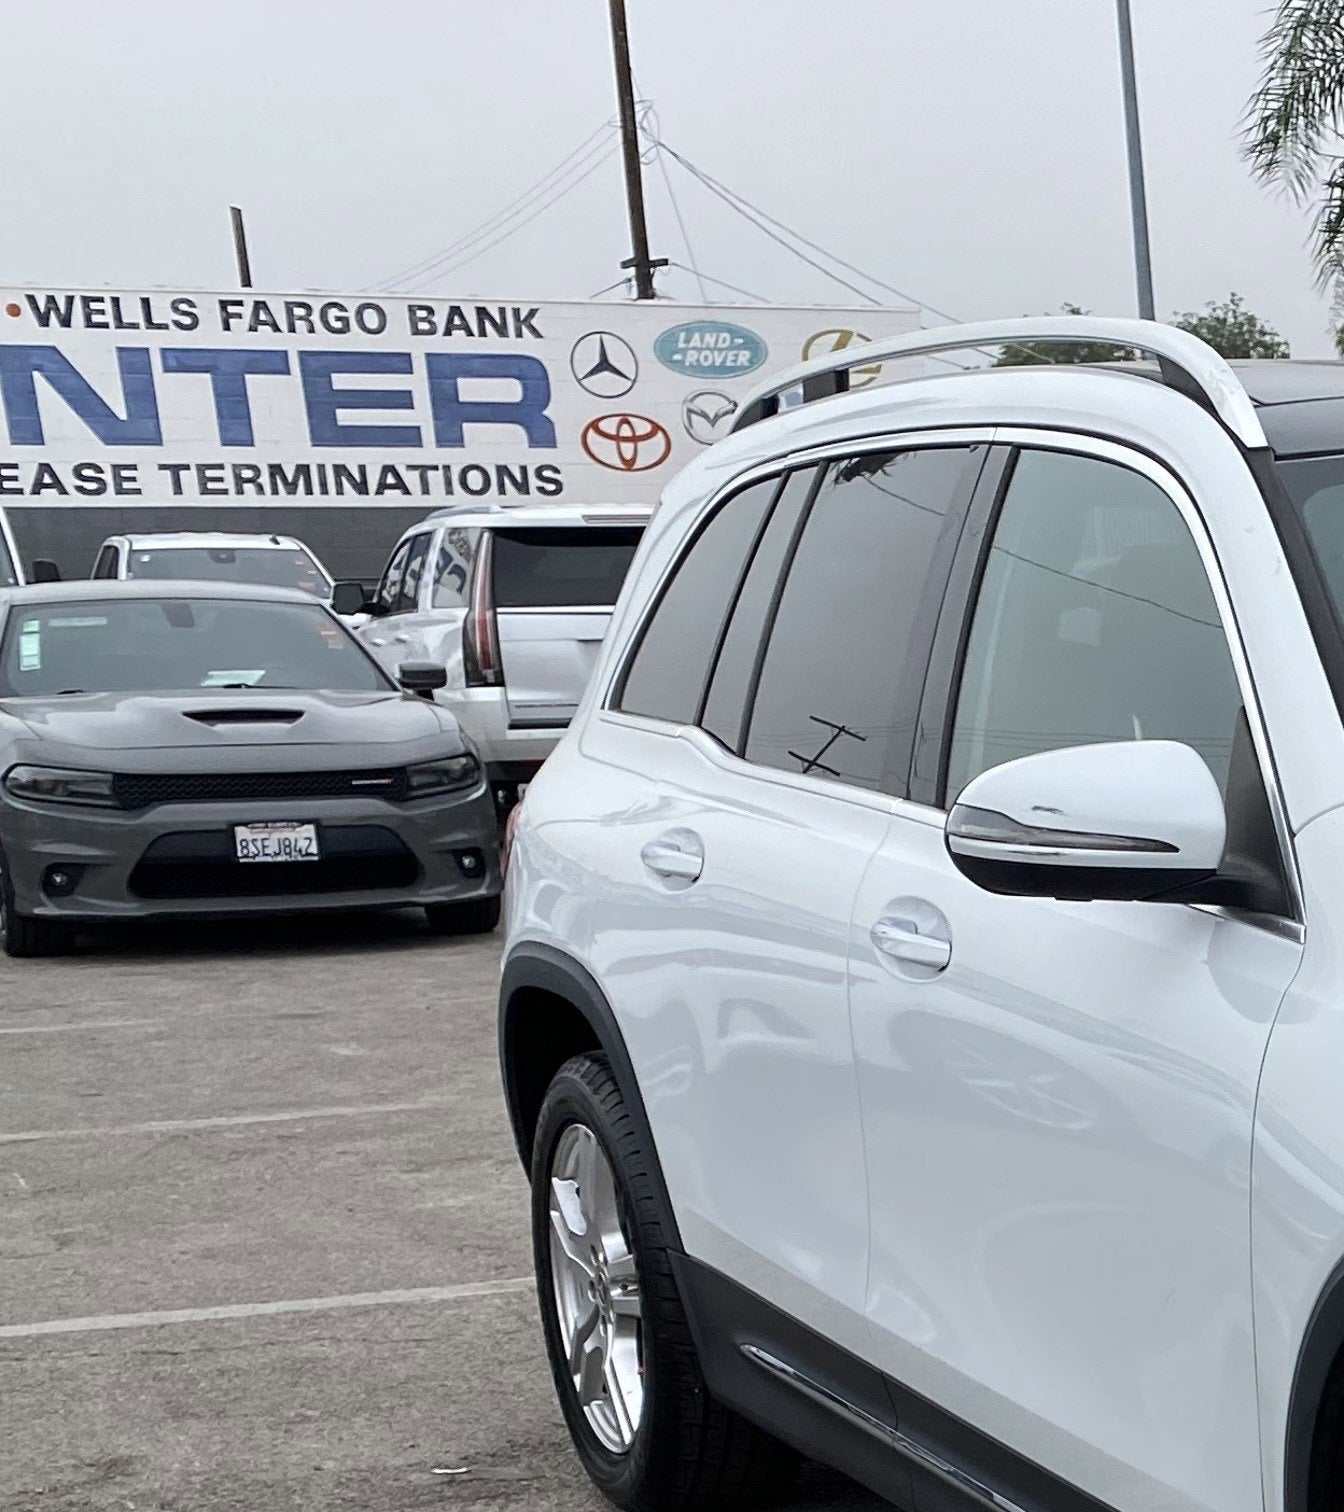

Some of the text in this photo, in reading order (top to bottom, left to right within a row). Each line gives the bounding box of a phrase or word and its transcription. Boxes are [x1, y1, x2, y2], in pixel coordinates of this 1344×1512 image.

[25, 294, 544, 338] WELLS FARGO BANK
[0, 344, 557, 448] NTER
[0, 462, 564, 496] EASE TERMINATIONS
